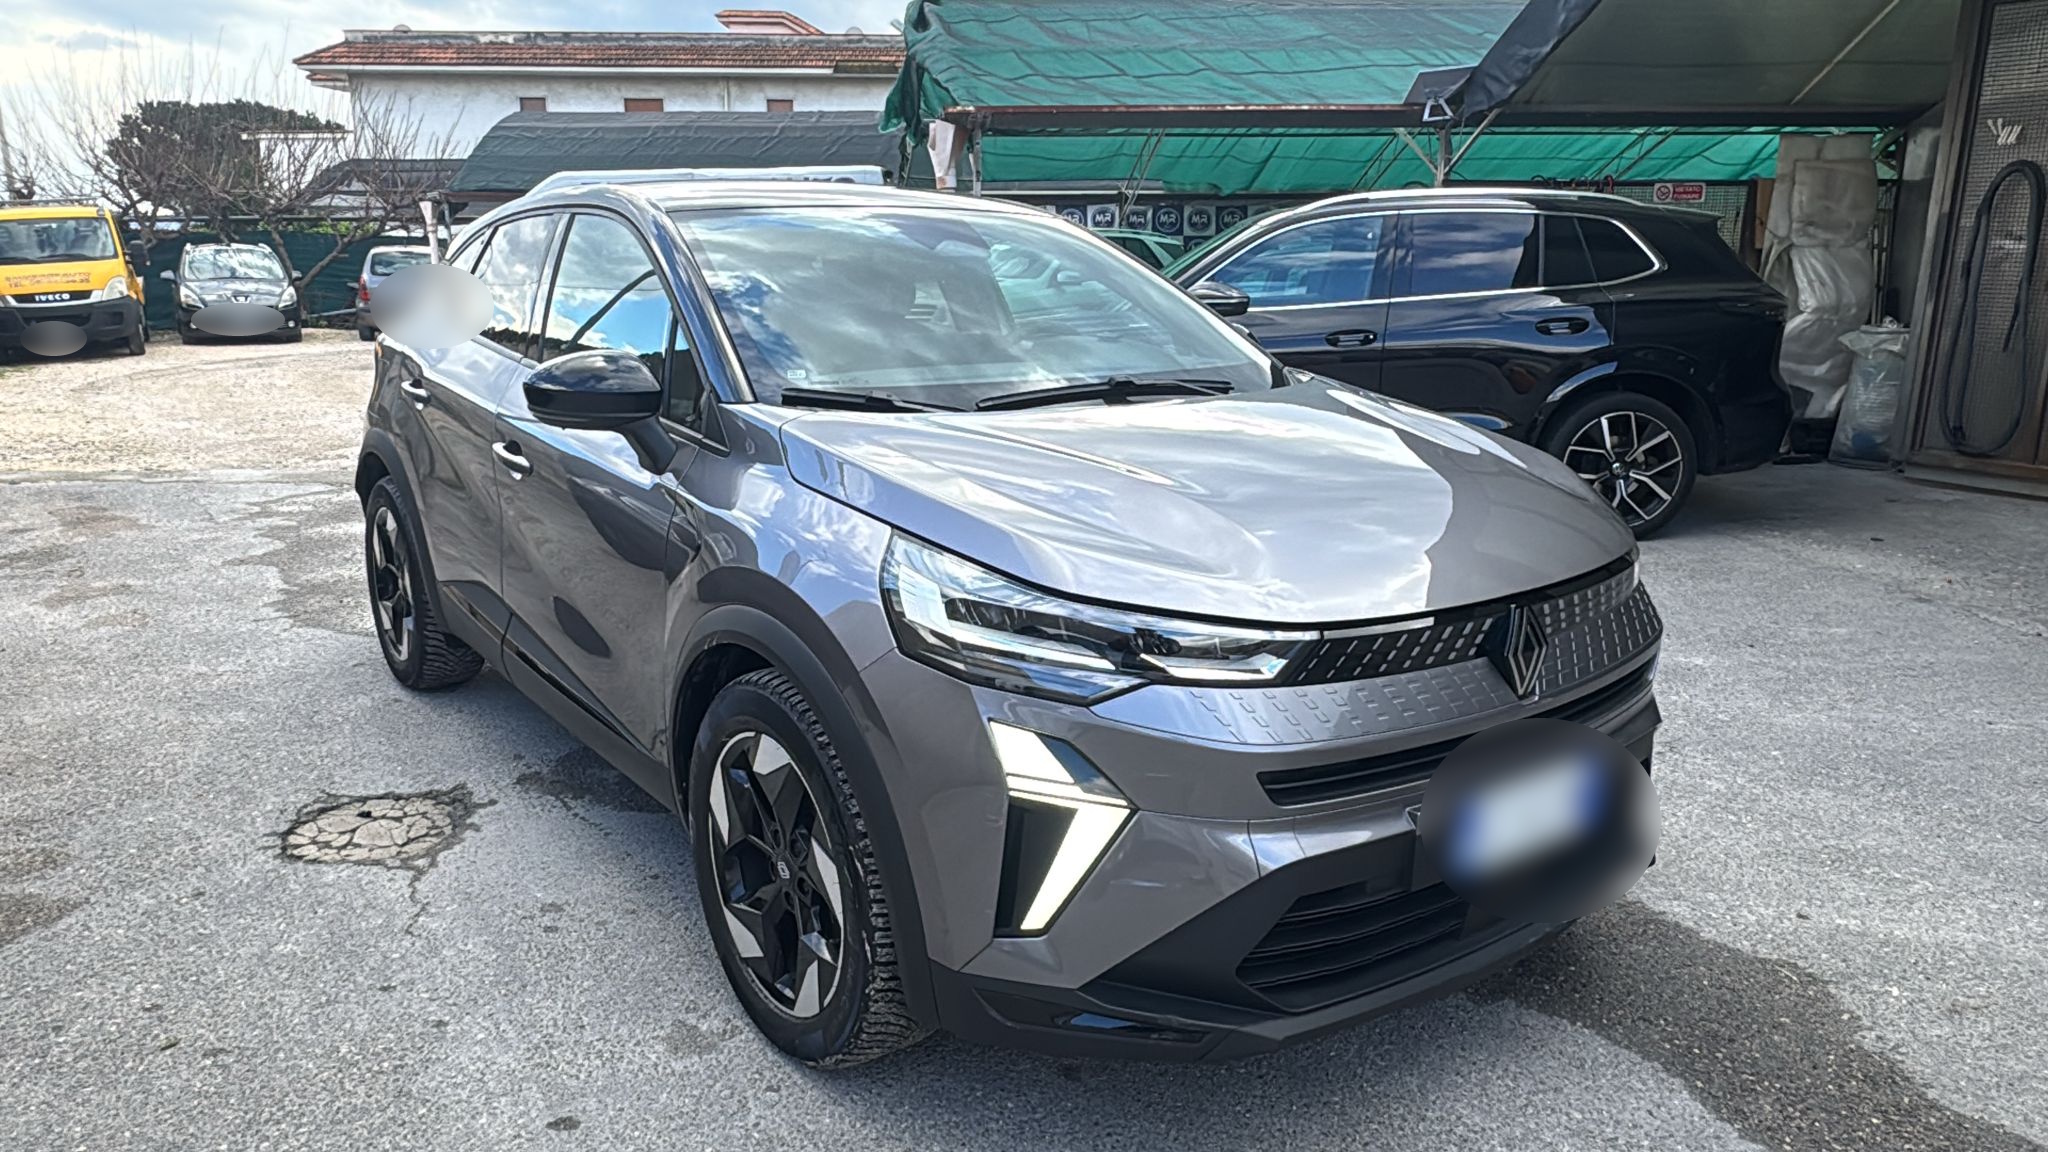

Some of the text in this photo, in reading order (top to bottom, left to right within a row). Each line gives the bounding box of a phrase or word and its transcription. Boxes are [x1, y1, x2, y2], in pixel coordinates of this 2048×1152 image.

[1095, 213, 1112, 223] MR
[1129, 214, 1145, 223] MR
[1160, 213, 1177, 224] MR
[1191, 214, 1208, 224] MR
[1223, 214, 1241, 224] MR
[34, 293, 71, 301] IVECO
